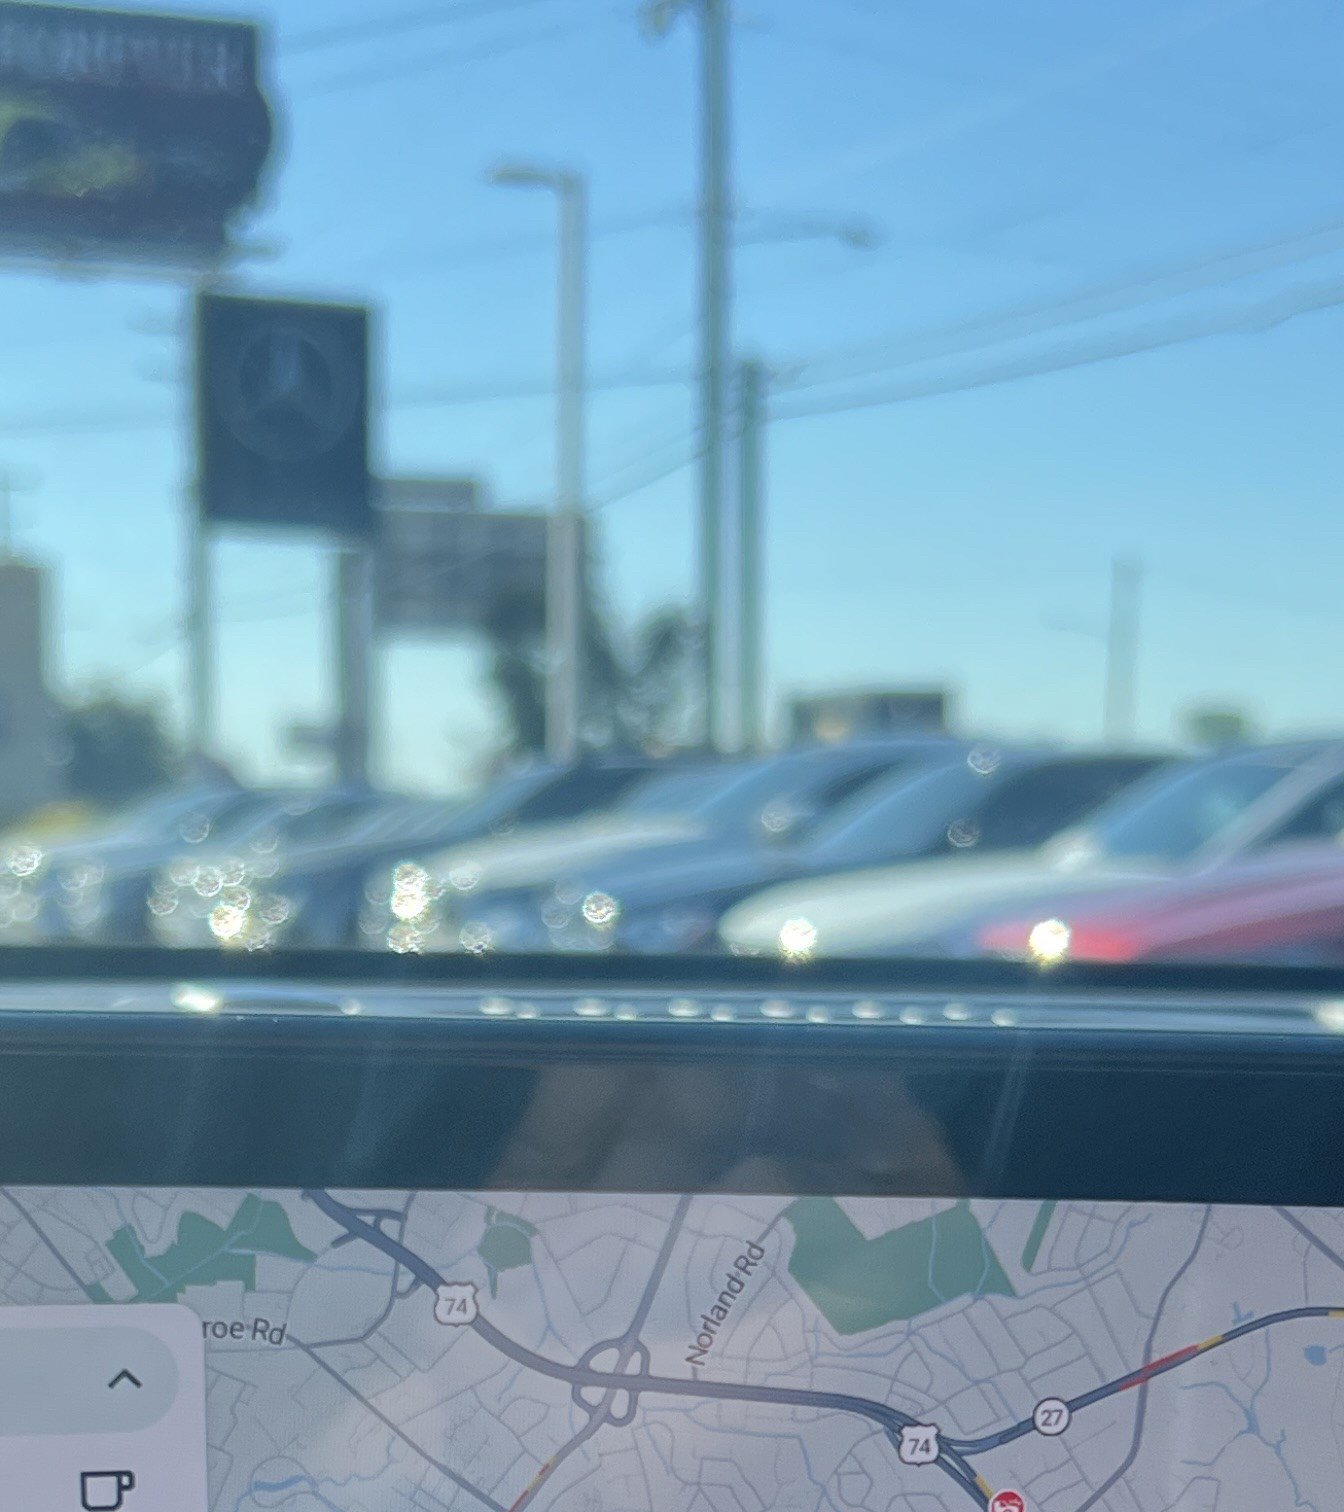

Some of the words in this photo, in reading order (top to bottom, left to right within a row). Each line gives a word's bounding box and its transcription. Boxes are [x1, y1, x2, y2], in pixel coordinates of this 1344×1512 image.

[444, 1297, 469, 1316] 74
[686, 1270, 748, 1367] Norland
[736, 1240, 765, 1277] Rd
[251, 1317, 287, 1345] Rd
[1041, 1408, 1064, 1428] 27
[907, 1436, 931, 1456] 74
